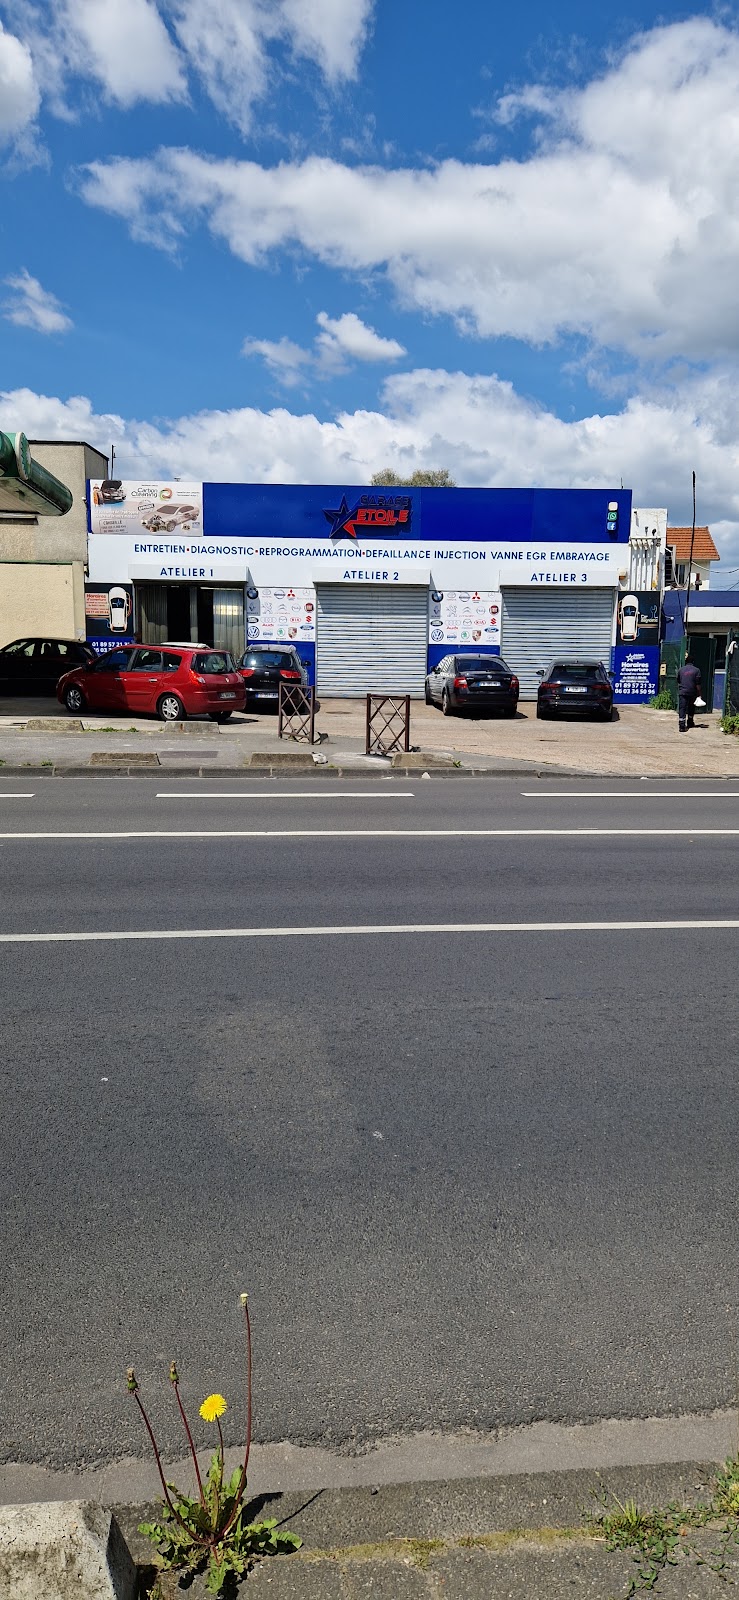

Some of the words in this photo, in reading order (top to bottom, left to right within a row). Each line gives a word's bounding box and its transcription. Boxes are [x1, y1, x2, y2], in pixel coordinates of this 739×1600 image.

[131, 491, 158, 499] Cleaning
[360, 495, 410, 506] GARAGE
[357, 509, 409, 523] ETOILE
[134, 543, 186, 554] ENTRETIEN
[190, 545, 254, 556] DIAGNOSTIC
[259, 548, 362, 558] REPROGRAMMATION
[365, 549, 431, 559] DEFAILLANCE
[434, 550, 486, 560] INJECTION
[491, 551, 524, 560] VANNE
[526, 552, 547, 561] EGR
[550, 552, 610, 562] EMBRAYAGE
[160, 567, 206, 577] ATELIER
[210, 568, 214, 577] 1
[343, 570, 389, 580] ATELIER
[393, 571, 400, 581] 2
[530, 572, 577, 582] ATELIER
[581, 573, 588, 583] 3
